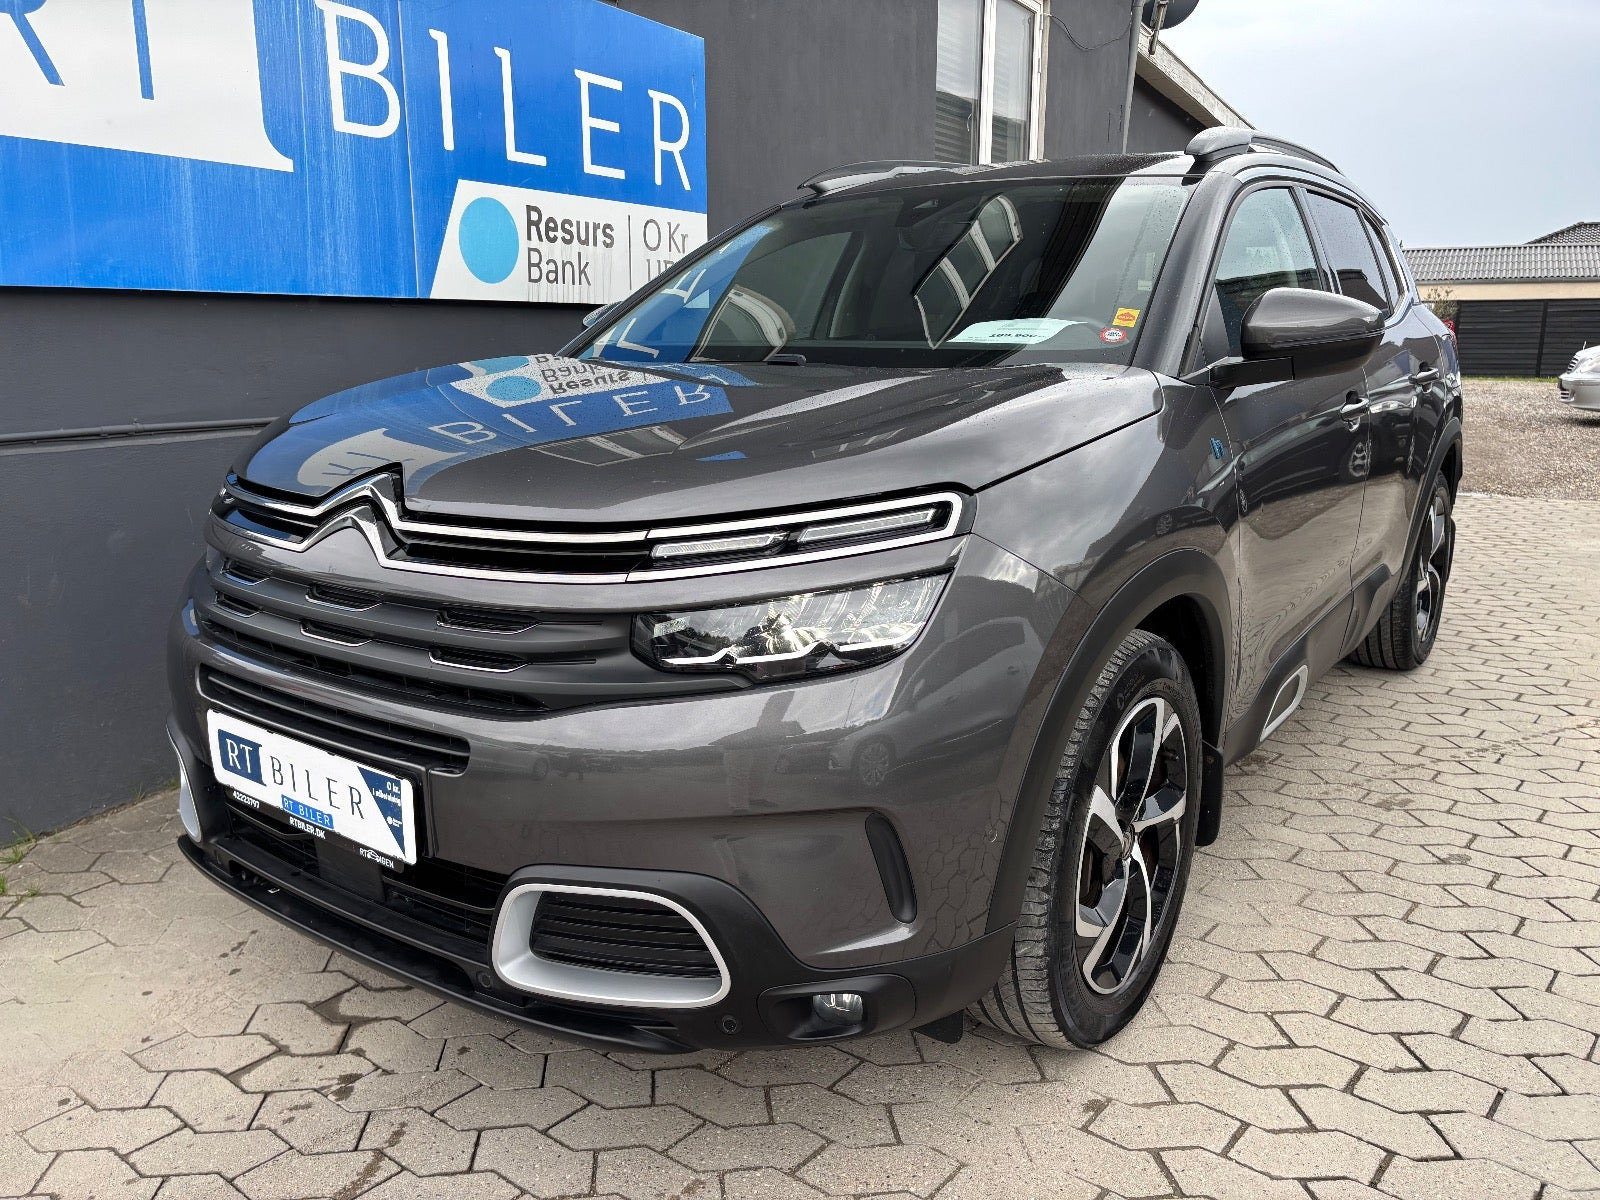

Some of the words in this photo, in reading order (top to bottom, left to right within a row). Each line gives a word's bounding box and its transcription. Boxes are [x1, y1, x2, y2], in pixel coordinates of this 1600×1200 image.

[316, 0, 692, 191] BILER
[525, 204, 615, 249] Resurs
[667, 221, 689, 254] Kr
[527, 247, 592, 287] Bank
[225, 738, 253, 774] RT
[270, 755, 365, 820] BILER
[283, 797, 293, 811] RT
[299, 802, 331, 826] BILER
[289, 816, 326, 840] RTBILER.DK
